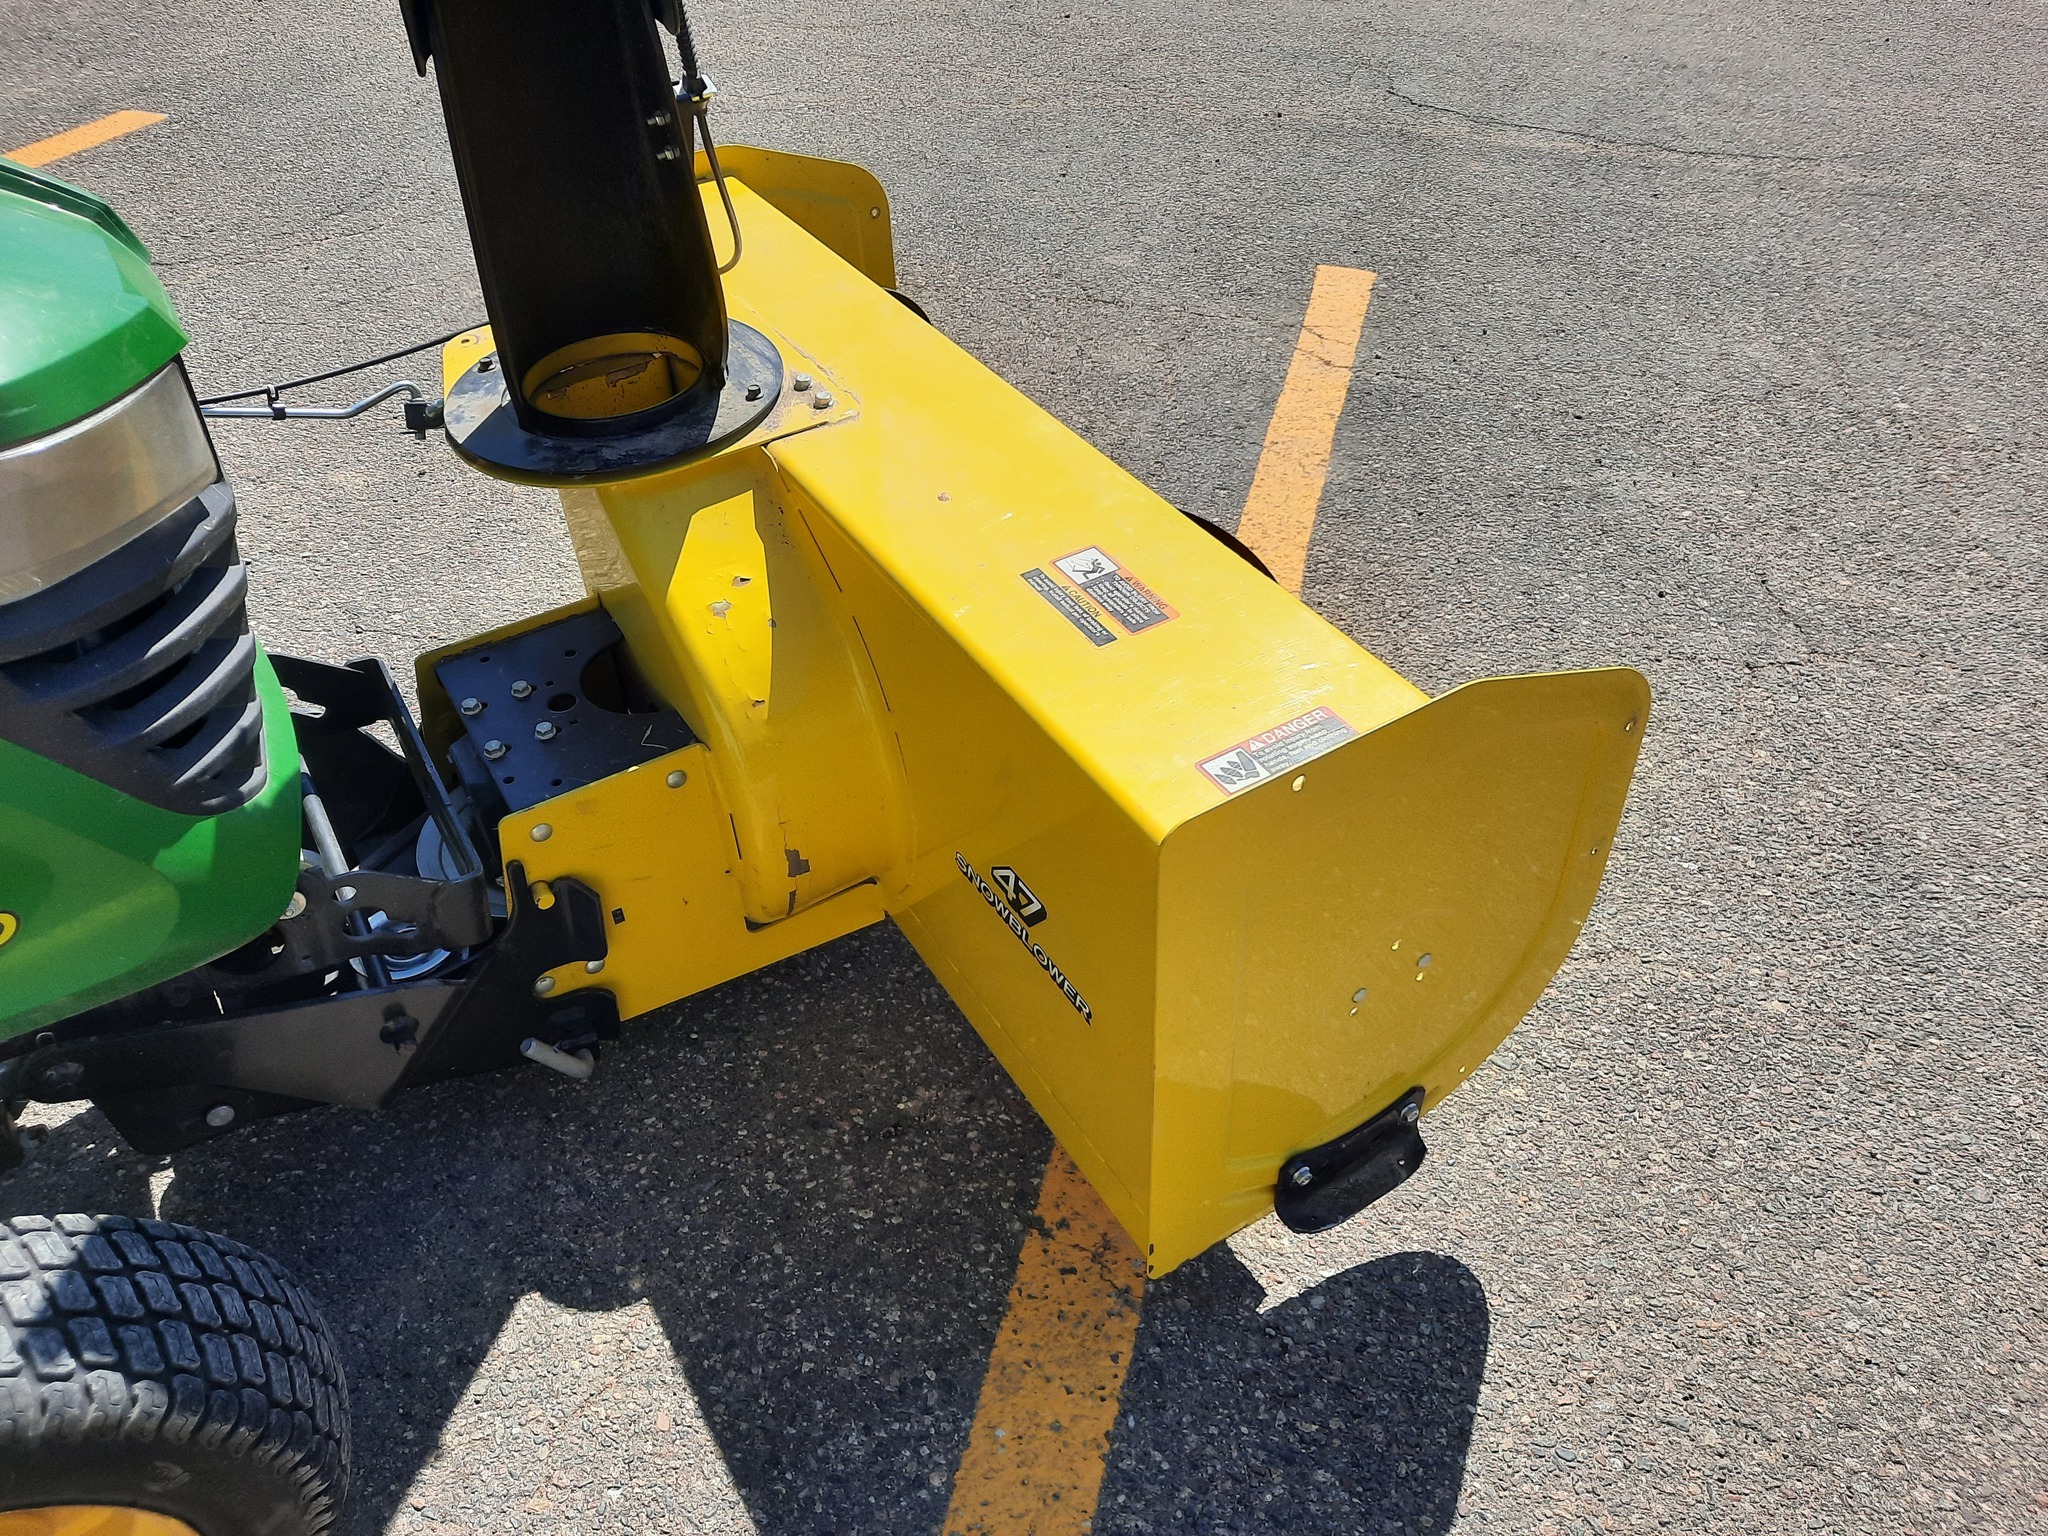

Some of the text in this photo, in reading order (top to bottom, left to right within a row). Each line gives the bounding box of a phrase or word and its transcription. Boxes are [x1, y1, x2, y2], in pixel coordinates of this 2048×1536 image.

[1069, 590, 1102, 618] CAUTION
[1132, 581, 1168, 610] WARNING
[1261, 710, 1328, 743] DANGER
[1264, 741, 1284, 751] avoid
[1305, 725, 1322, 735] from
[1304, 742, 1318, 750] and
[1319, 727, 1347, 743] clothing
[1259, 747, 1288, 762] rotating
[990, 865, 1048, 928] 47
[954, 851, 1093, 1027] SNOWBLOWER
